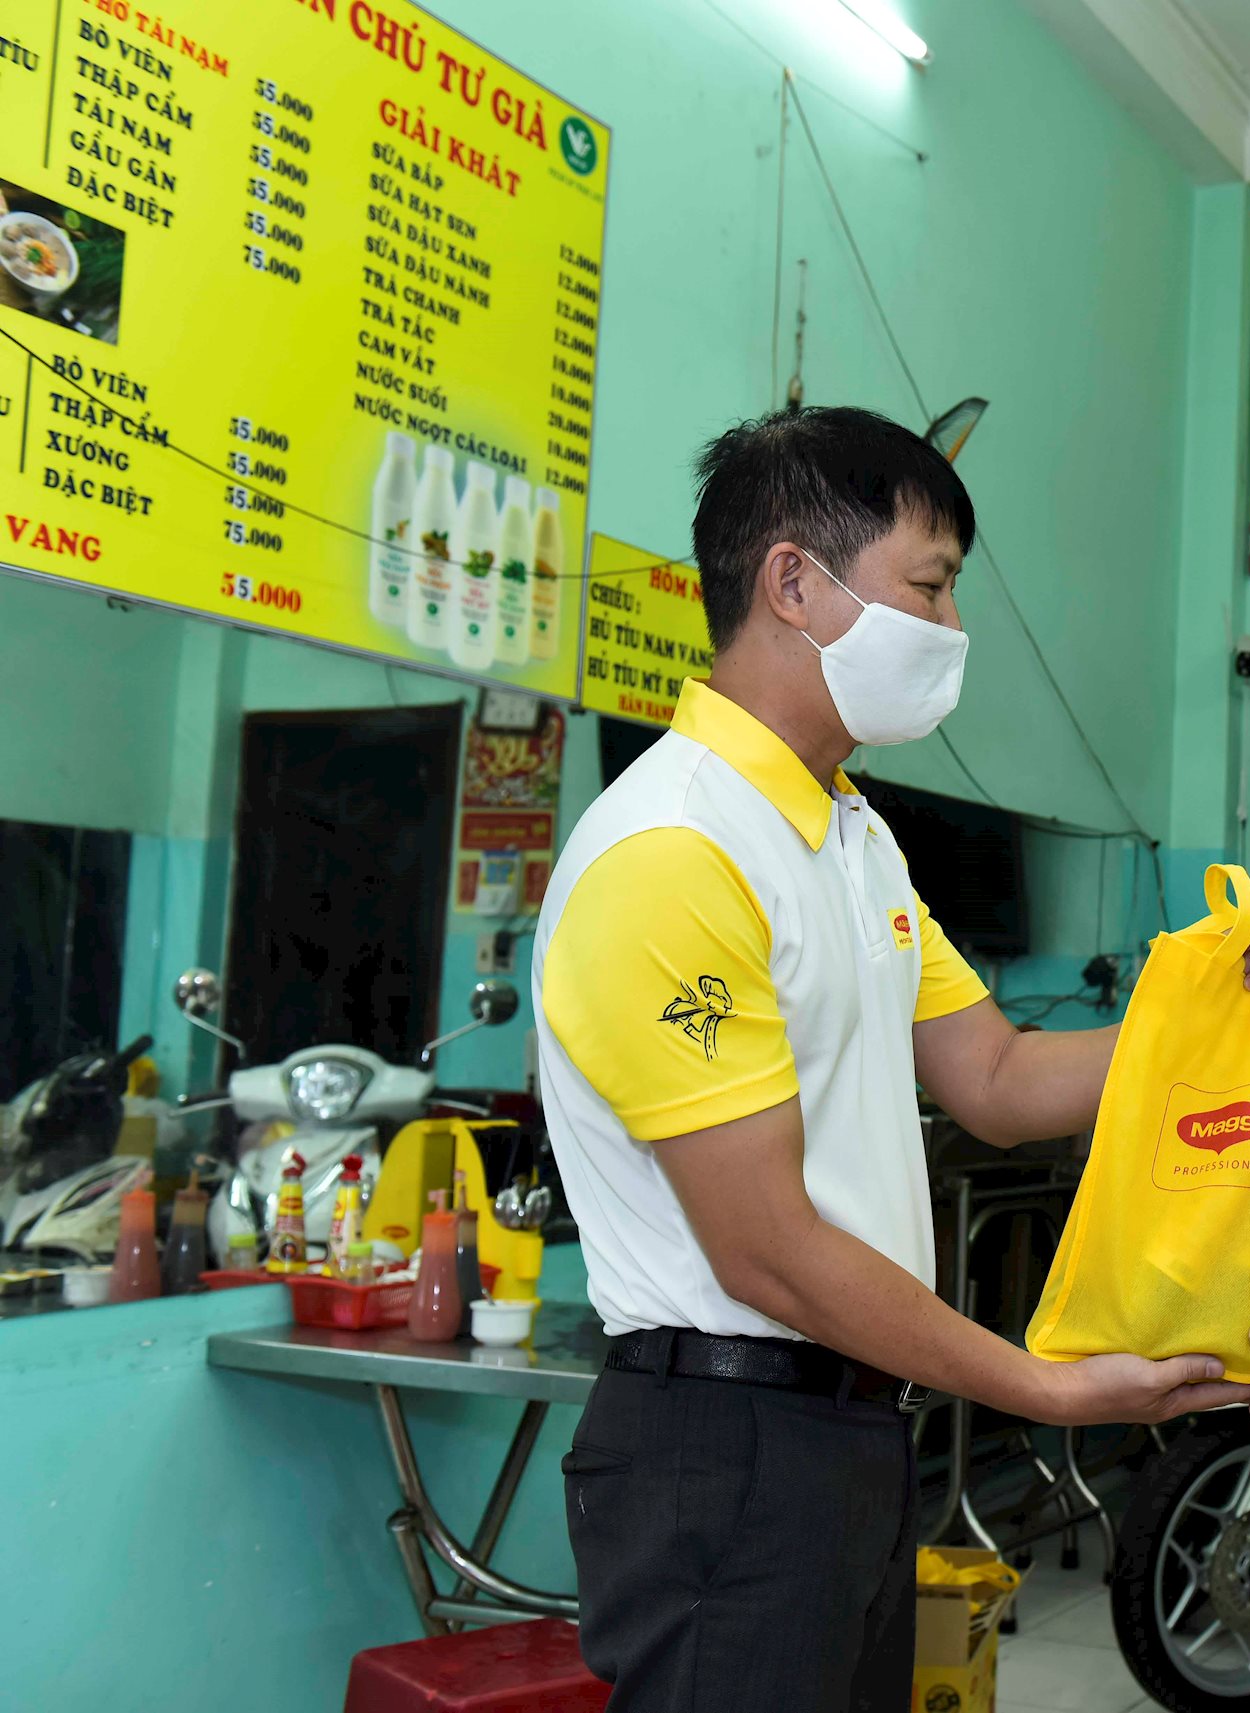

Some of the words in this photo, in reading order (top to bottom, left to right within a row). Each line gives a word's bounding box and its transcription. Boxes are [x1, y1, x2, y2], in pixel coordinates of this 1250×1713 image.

[79, 18, 110, 49] BÒ
[117, 38, 173, 82] VIÊN
[136, 12, 175, 48] TÁI
[180, 36, 229, 78] NẠM
[349, 0, 427, 73] CHÚ
[436, 50, 486, 107] TƯ
[491, 87, 548, 151] GIÀ
[77, 55, 139, 100] THẬP
[145, 91, 193, 130] CẨM
[73, 91, 115, 128] TÁI
[121, 115, 172, 156] NẠM
[379, 99, 441, 153] GIẢI
[448, 135, 521, 197] KHÁT
[70, 130, 122, 168] GẦU
[128, 159, 177, 193] GÂN
[372, 142, 406, 174] SỮA
[67, 165, 117, 203] ĐẶC
[123, 191, 174, 228] BIỆT
[370, 173, 404, 204] SỮA
[408, 193, 443, 223] HẠT
[447, 214, 478, 241] SEN
[365, 235, 399, 266] SỮA
[404, 254, 441, 285] ĐẬU
[367, 204, 401, 235] SỮA
[406, 223, 443, 254] ĐẬU
[446, 244, 492, 280] XANH
[360, 298, 395, 328] TRÀ
[363, 266, 398, 297] TRÀ
[403, 286, 460, 326] CHANH
[358, 330, 396, 360] CAM
[52, 355, 83, 381] BÒ
[91, 368, 148, 403] VIÊN
[408, 385, 448, 413] SUỐI
[50, 392, 114, 429] THẬP
[120, 411, 169, 448] CẨM
[406, 412, 452, 445] NGỌT
[455, 432, 487, 458] CÁC
[490, 446, 528, 473] LOẠI
[46, 430, 129, 472] XƯƠNG
[44, 467, 94, 498] ĐẶC
[101, 486, 153, 516] BIỆT
[5, 514, 102, 563] VANG
[221, 572, 302, 614] 55.000
[643, 632, 675, 659] NAM
